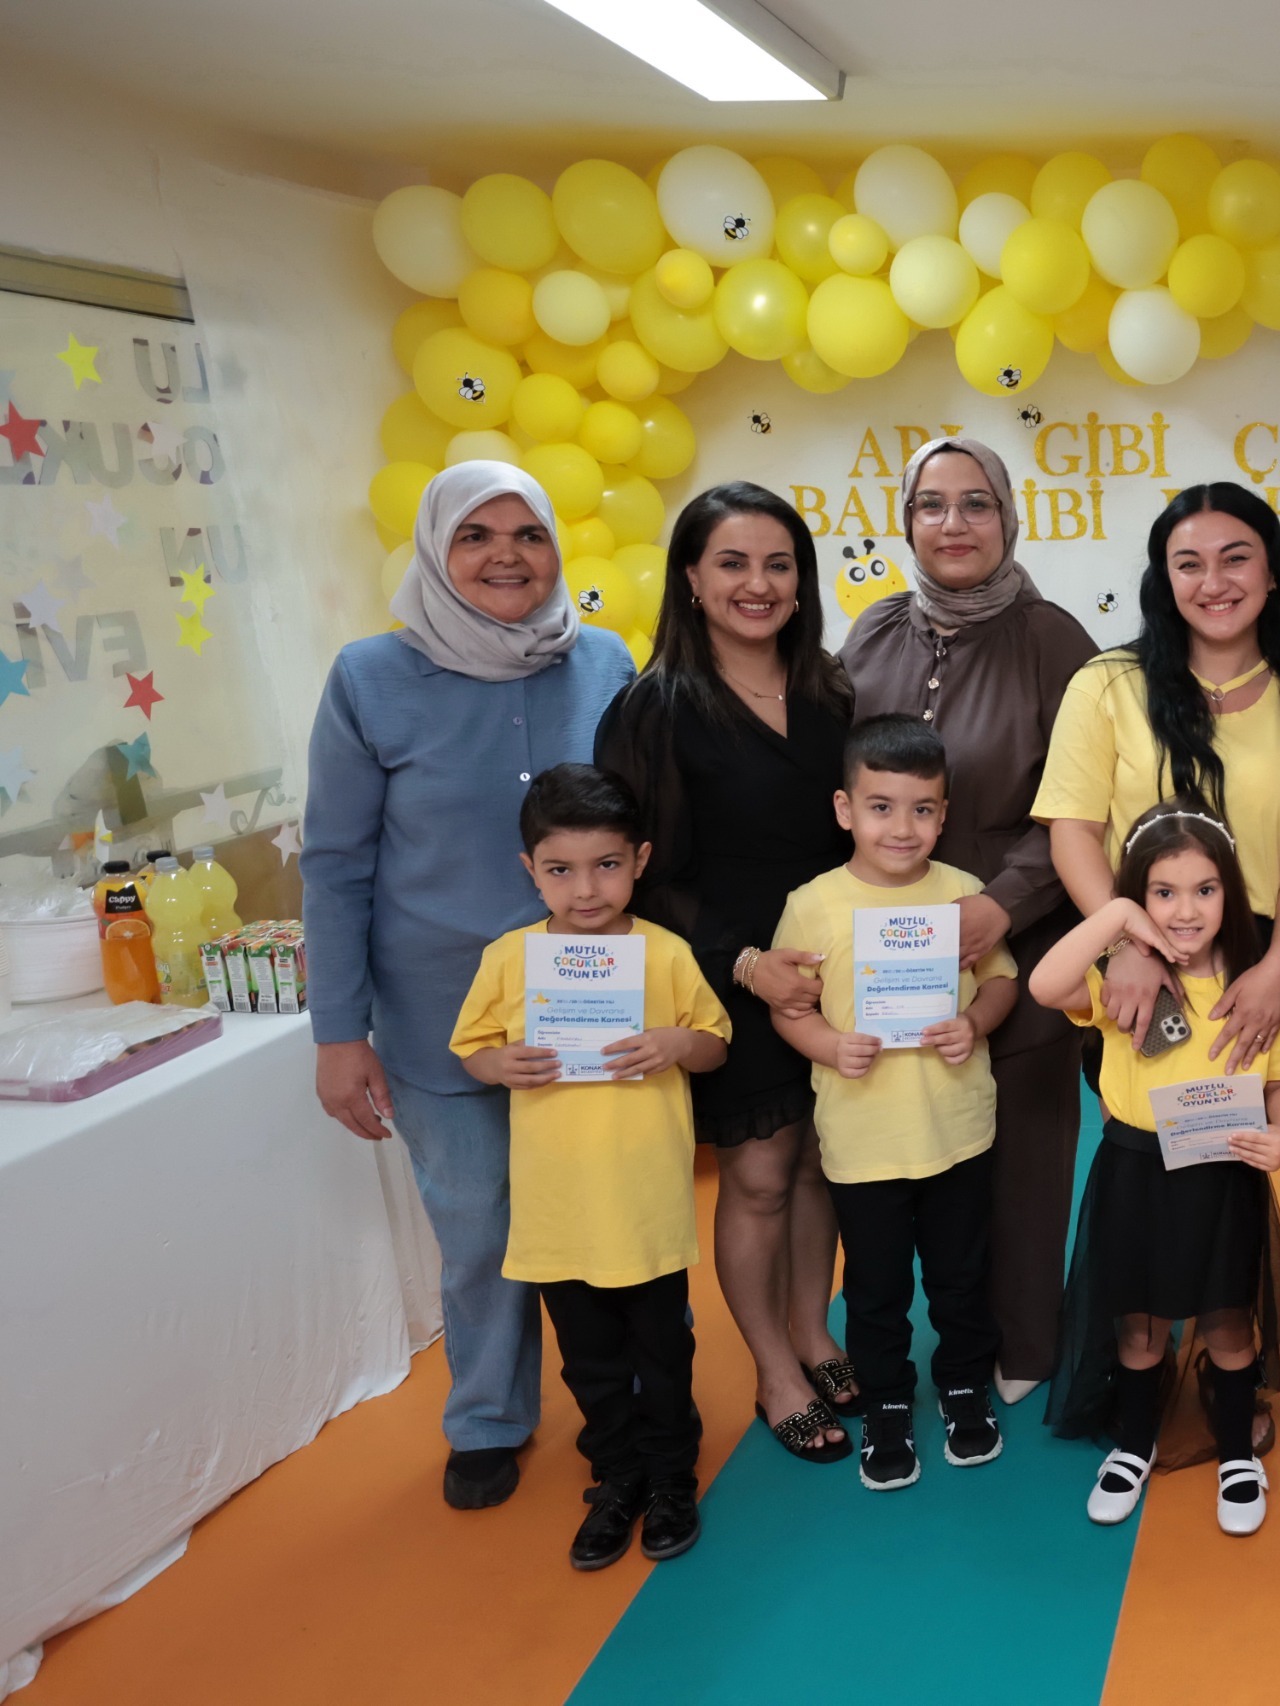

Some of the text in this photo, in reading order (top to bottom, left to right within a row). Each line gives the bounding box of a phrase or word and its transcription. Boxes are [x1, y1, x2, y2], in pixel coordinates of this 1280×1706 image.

[1034, 411, 1171, 478] GİBİ
[1012, 478, 1107, 541] İBİ
[889, 916, 926, 926] MUTLU
[880, 927, 933, 938] ÇOCUKLAR
[884, 937, 930, 949] OYUN EVİ
[564, 945, 606, 955] MUTLU
[554, 956, 614, 967] ÇOCUKLAR
[559, 967, 611, 978] OYUN EVİ
[867, 982, 949, 993] Değerlendirme Karnesi
[1186, 1083, 1224, 1093] MUTLU
[1177, 1088, 1234, 1102] ÇOCUKLAR
[1182, 1095, 1231, 1107] OYUN EVİ
[948, 1388, 974, 1396] kinetix
